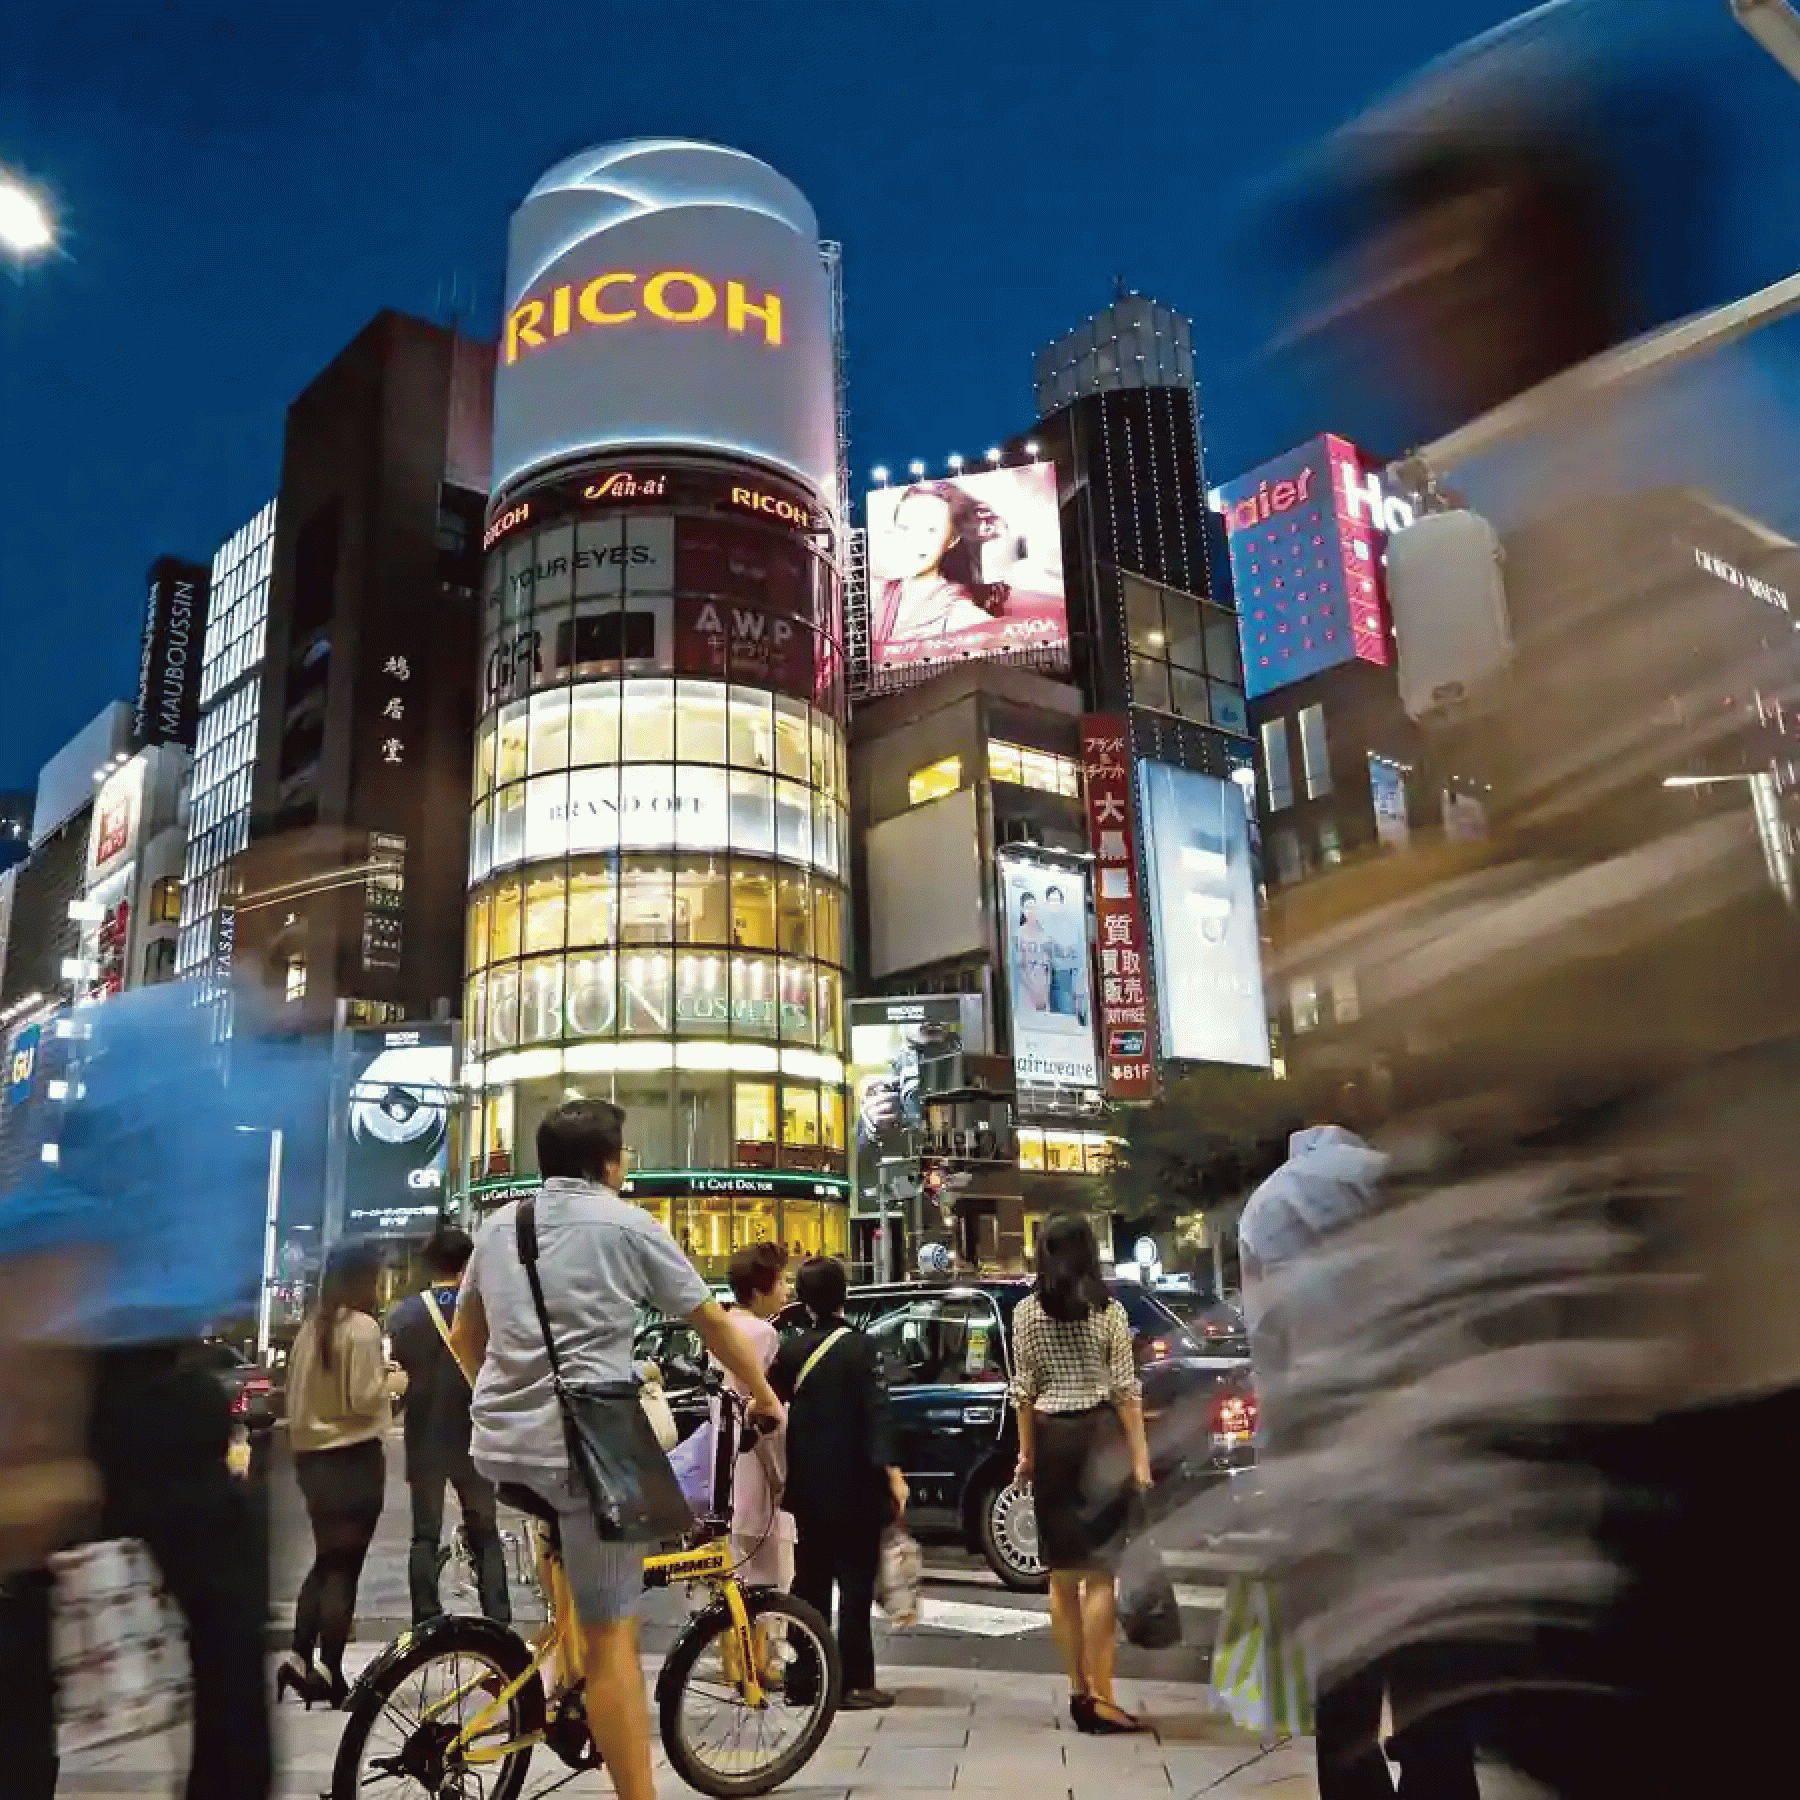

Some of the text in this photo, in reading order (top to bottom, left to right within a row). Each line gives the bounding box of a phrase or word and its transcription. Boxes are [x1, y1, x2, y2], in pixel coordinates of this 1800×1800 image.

[506, 271, 782, 366] RICOH
[732, 486, 808, 527] RICOH
[509, 556, 567, 592] YOUR
[159, 579, 195, 735] MAUBOUSSIN
[213, 904, 238, 978] TASAKI
